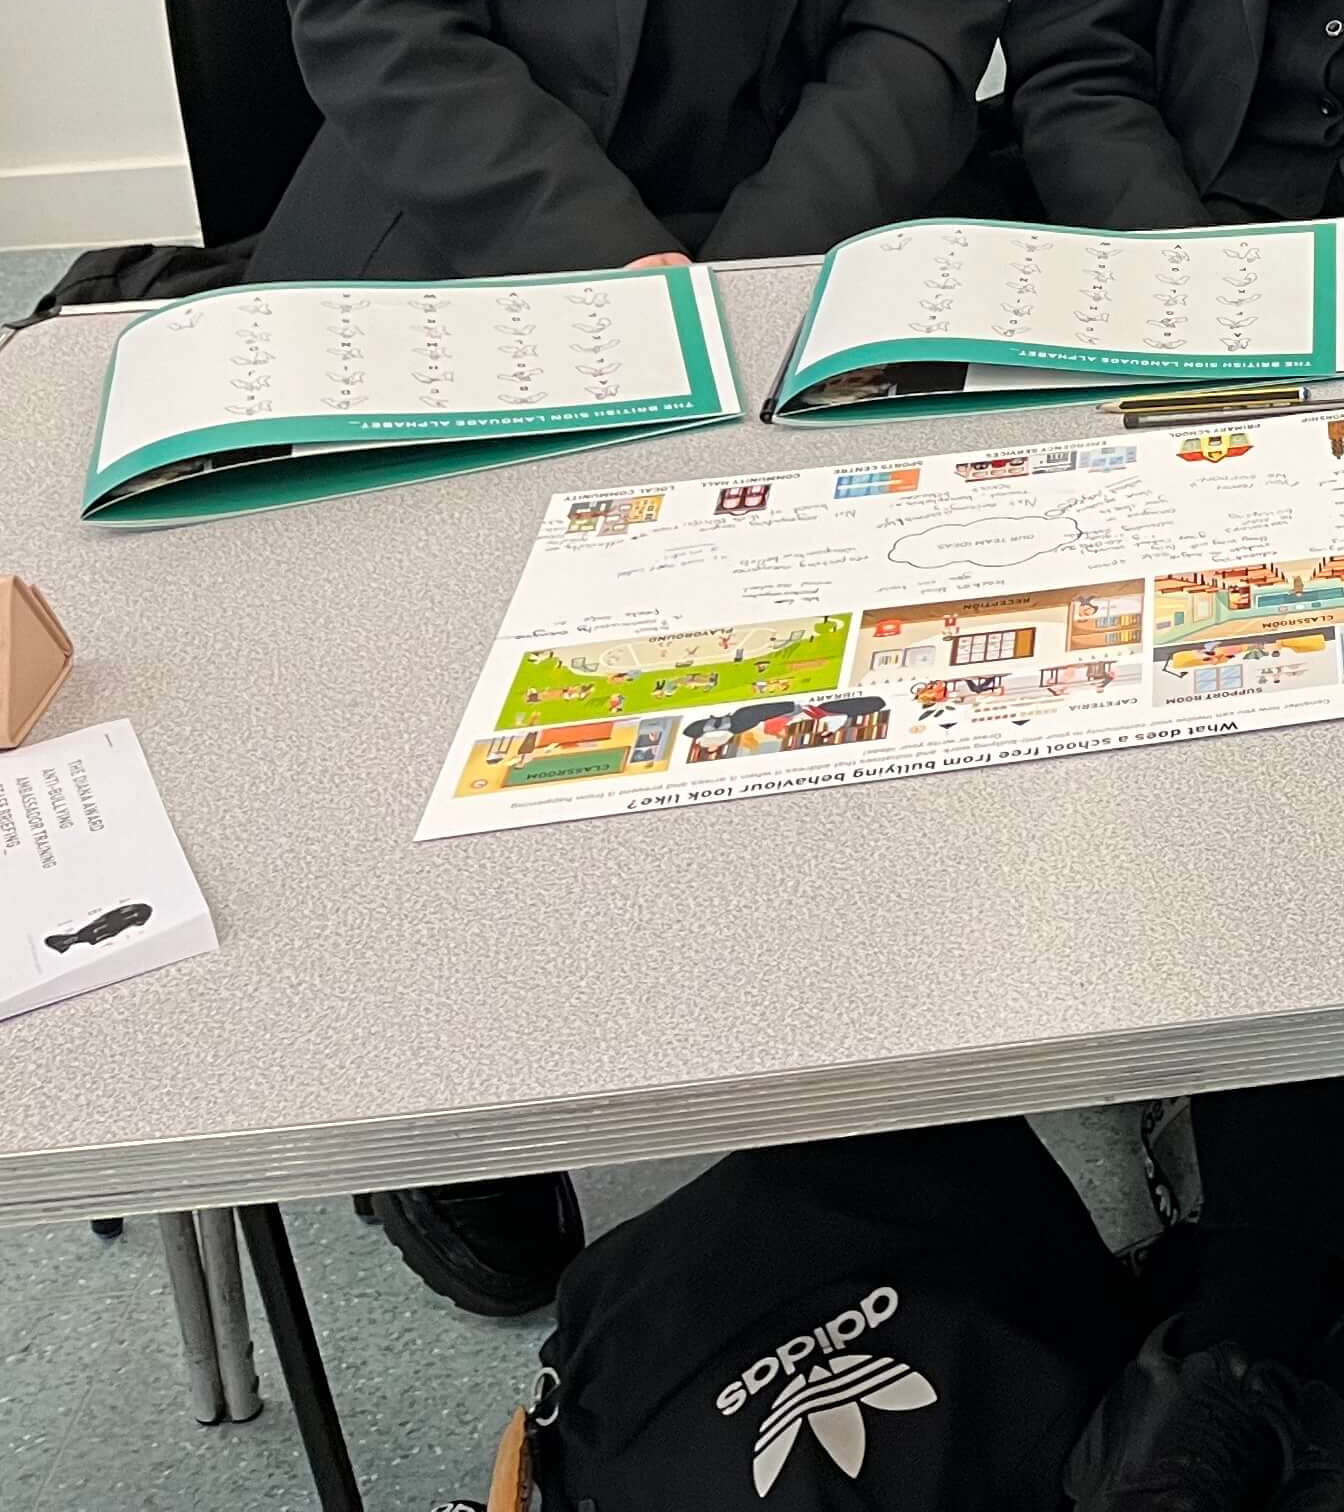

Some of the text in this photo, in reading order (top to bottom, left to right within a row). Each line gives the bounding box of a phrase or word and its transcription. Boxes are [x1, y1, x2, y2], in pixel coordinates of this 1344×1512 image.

[1099, 356, 1180, 368] LANGUAGE
[1183, 360, 1218, 369] SIGN
[1221, 360, 1281, 369] BRITISH
[1284, 360, 1312, 368] THE
[550, 411, 589, 422] SIGN
[593, 403, 659, 417] BRITISH
[455, 414, 546, 427] LANGUAGE
[1168, 423, 1261, 440] PRIMARY SCHOOL
[984, 440, 1107, 459] EMERGENCY SERVICES
[833, 460, 924, 475] SPORTS CENTRE
[700, 473, 801, 489] COMMUNITY HALL
[563, 484, 675, 502] LOCAL COMMUNITY
[936, 534, 1035, 551] OUR TEAM IDEAS
[961, 597, 1031, 610] RECEPTION
[1261, 614, 1334, 630] CLASSROOM
[647, 627, 734, 644] PLAYGROUND
[807, 690, 864, 703] LIBRARY
[1164, 686, 1263, 706] SUPPORT ROOM
[1068, 697, 1138, 712] CAFETERIA
[525, 763, 611, 781] CLASSROOM
[626, 721, 1239, 810] What does a school free from bullying behaviour look like?
[41, 767, 75, 830] ANTI-BULLYING
[67, 759, 105, 832] THE DIANA AWARD
[16, 776, 57, 869] AMBASSADOR TRAINING
[716, 1286, 899, 1416] adidas
